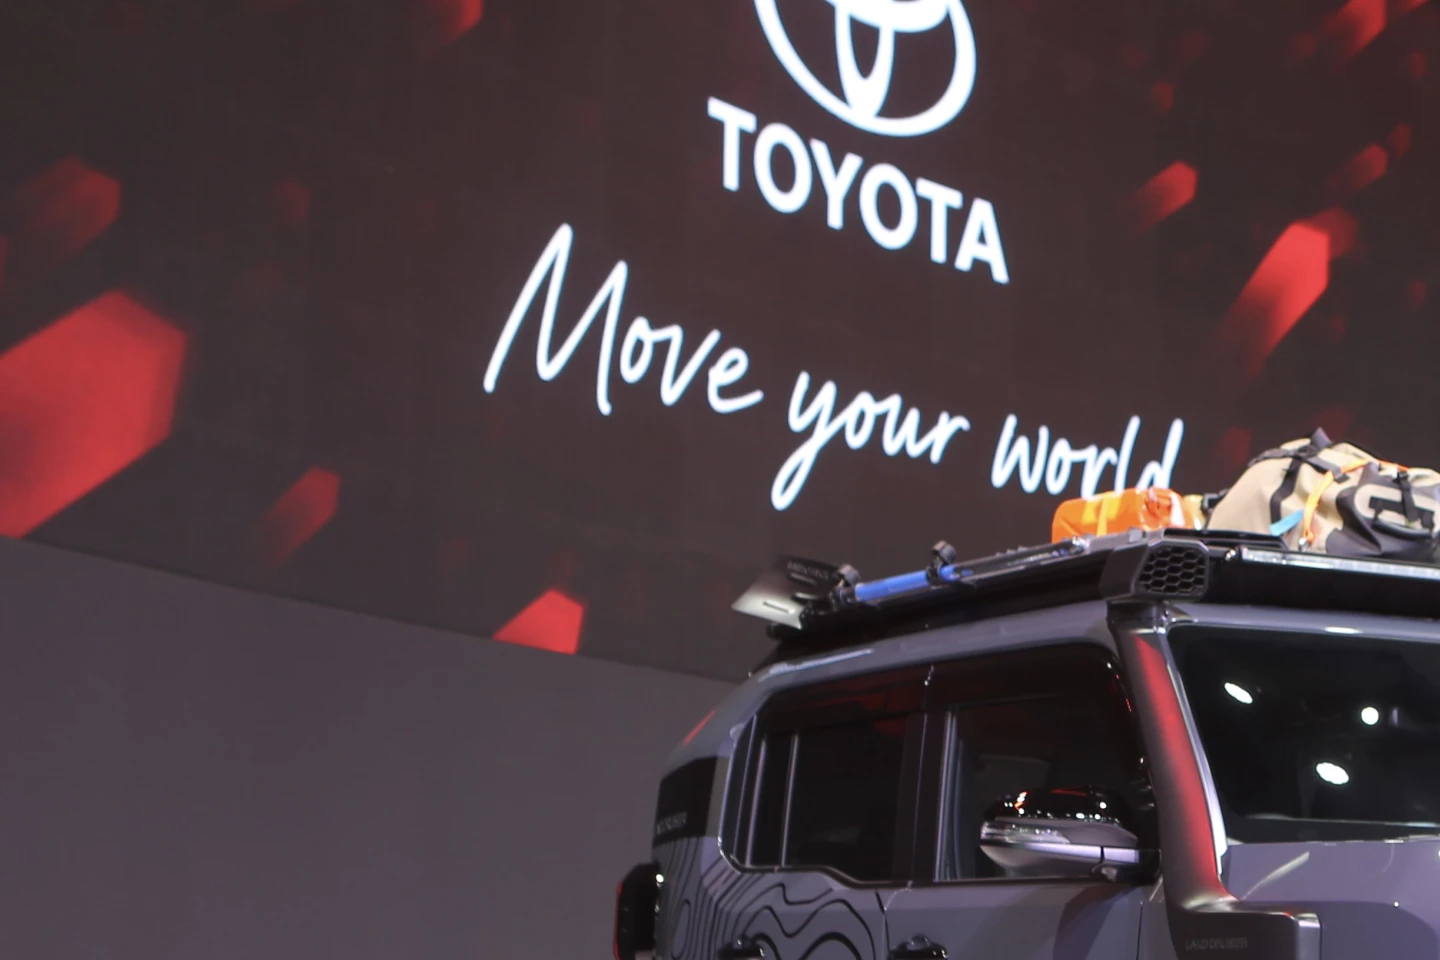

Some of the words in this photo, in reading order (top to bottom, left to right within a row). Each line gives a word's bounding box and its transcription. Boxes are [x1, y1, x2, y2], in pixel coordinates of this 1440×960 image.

[707, 96, 1010, 285] TOYOTA
[482, 222, 765, 416] Move
[770, 369, 971, 512] your
[991, 413, 1185, 500] world
